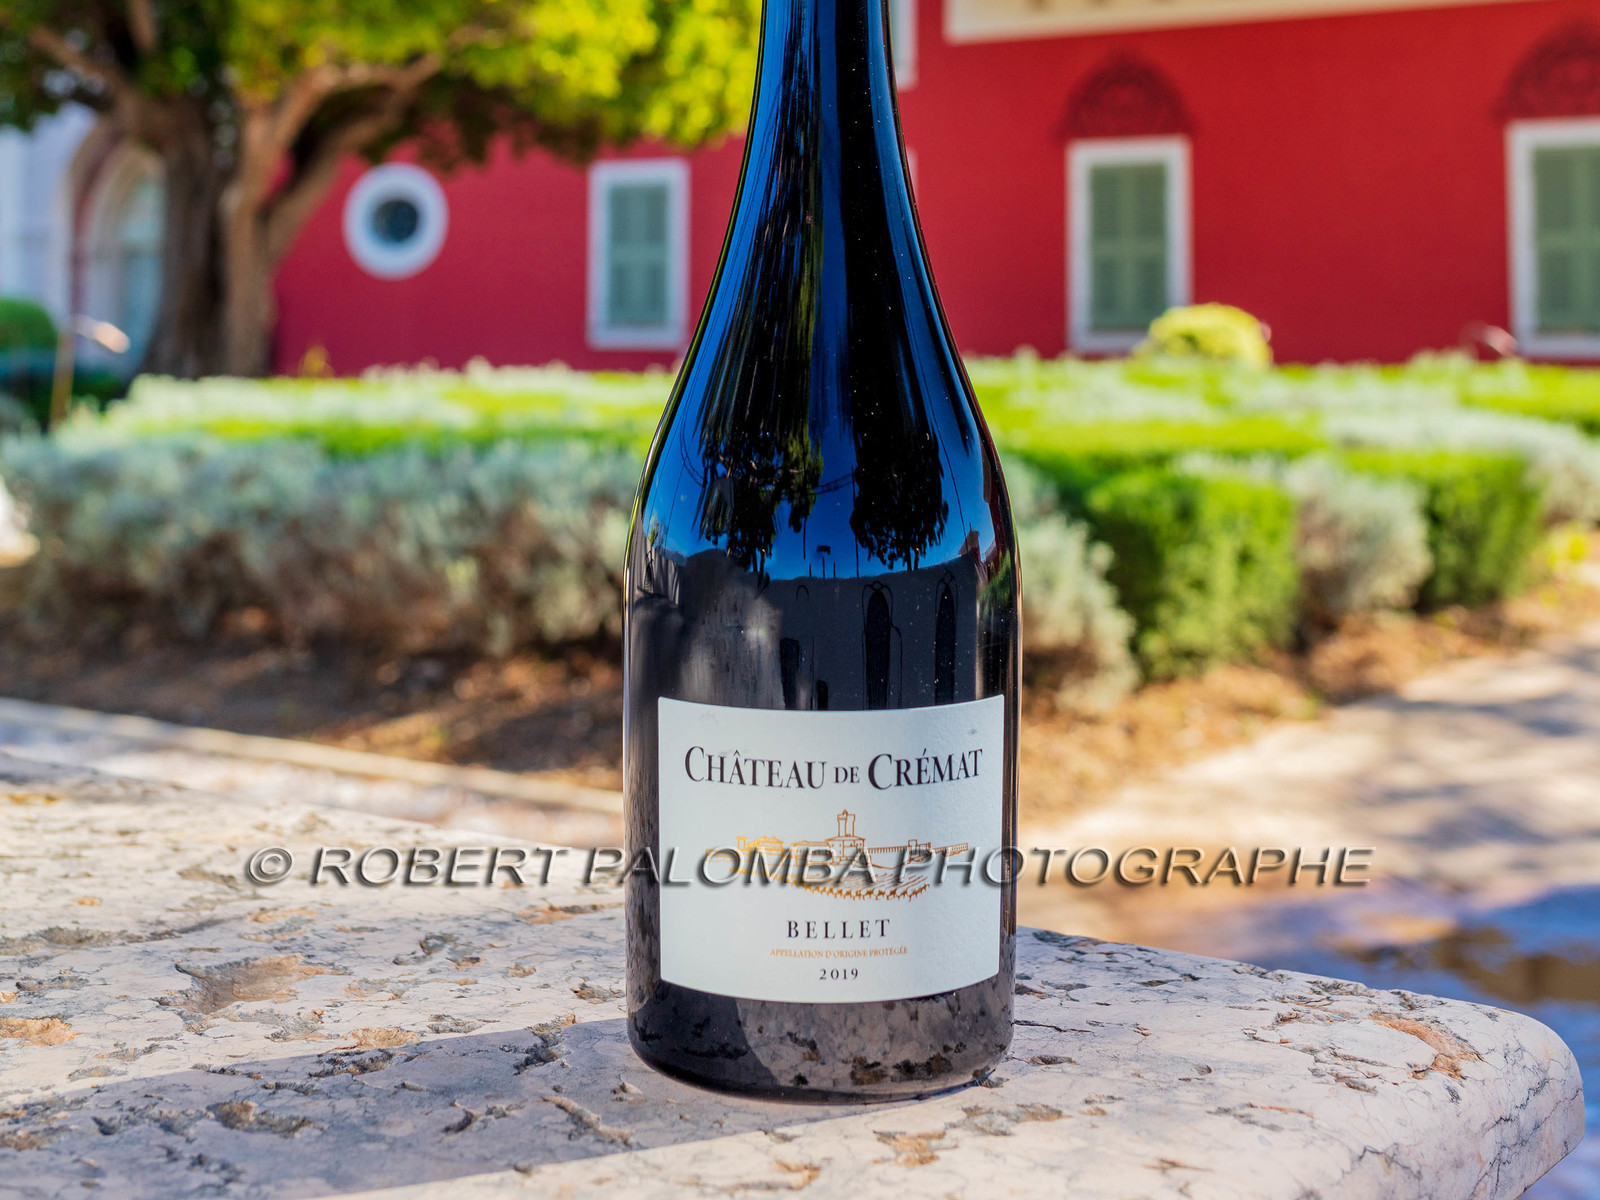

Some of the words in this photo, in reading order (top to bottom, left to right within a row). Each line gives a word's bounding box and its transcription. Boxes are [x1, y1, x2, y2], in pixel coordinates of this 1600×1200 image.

[684, 745, 828, 789] CHÂTEAU
[834, 765, 860, 785] DE
[867, 747, 983, 790] CRÉMAT
[786, 919, 890, 939] BELLET
[769, 948, 823, 959] APPELLATION
[819, 968, 859, 980] 2019
